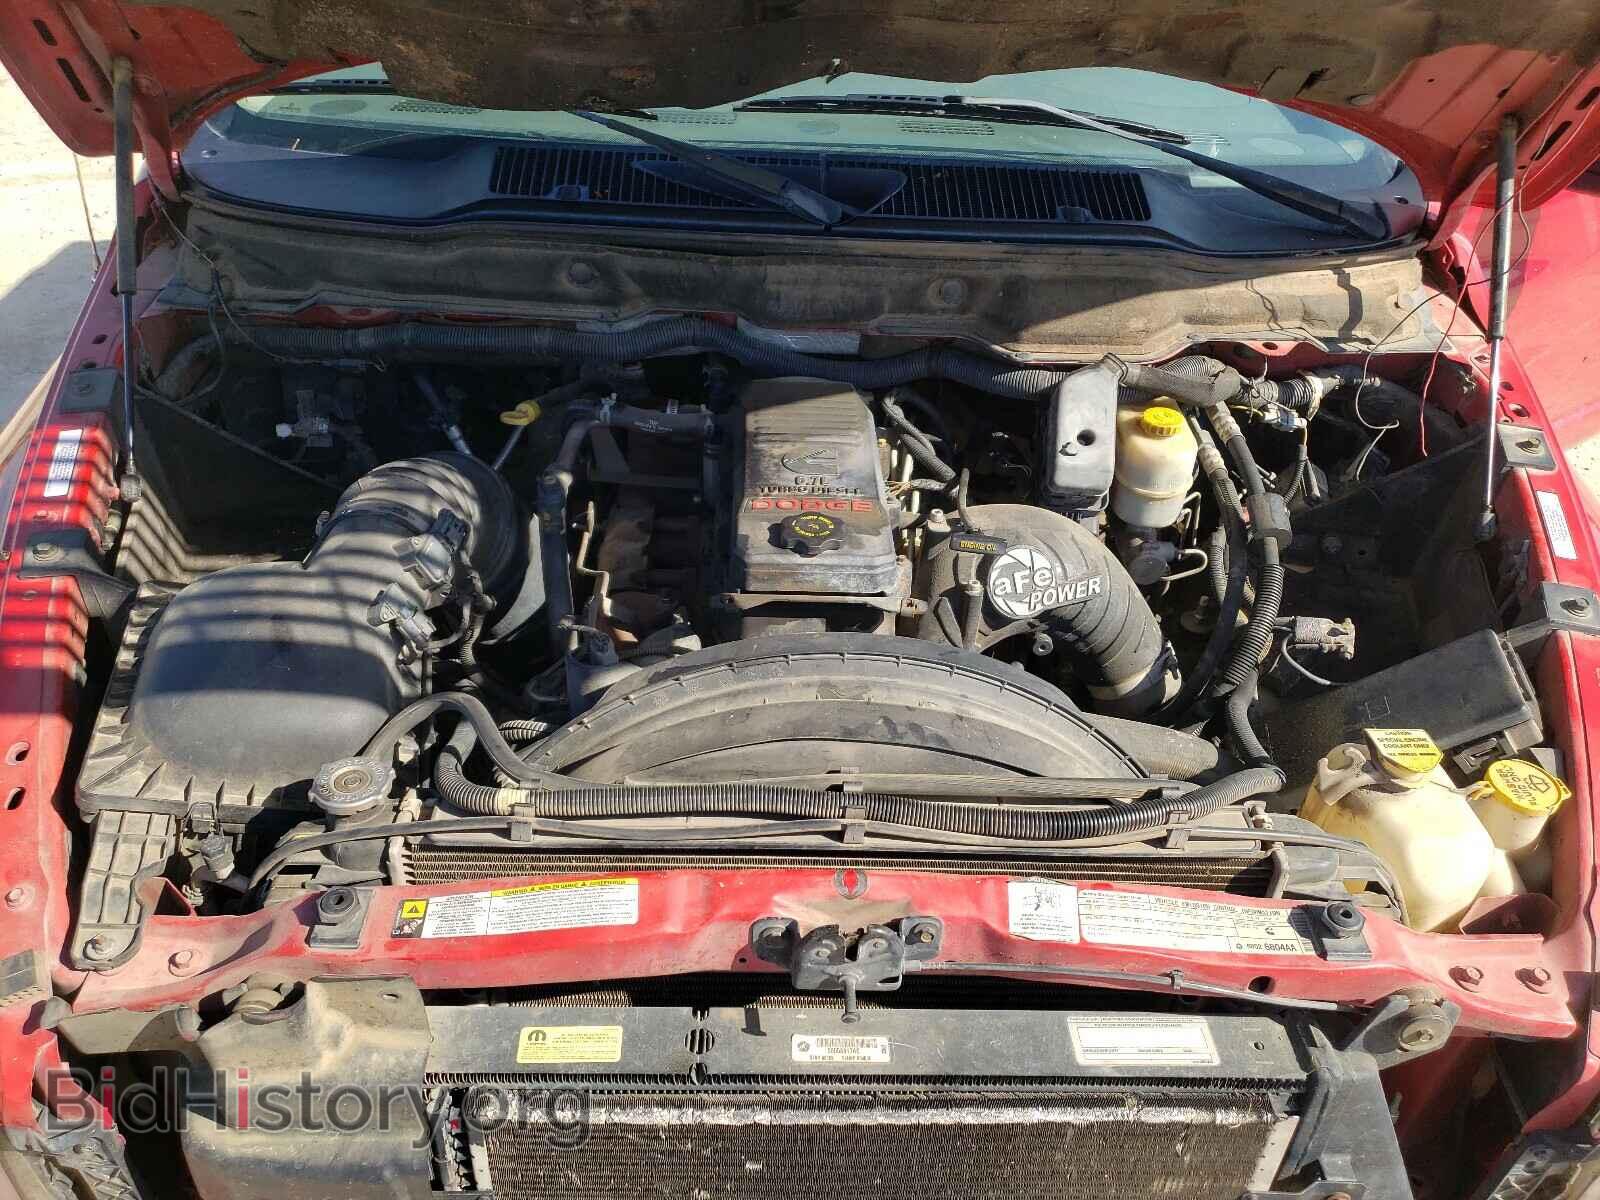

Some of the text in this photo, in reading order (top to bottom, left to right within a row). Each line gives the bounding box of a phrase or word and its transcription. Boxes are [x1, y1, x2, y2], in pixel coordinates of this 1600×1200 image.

[751, 497, 873, 512] DODGE
[994, 567, 1053, 597] aFe
[1030, 576, 1102, 612] POWER
